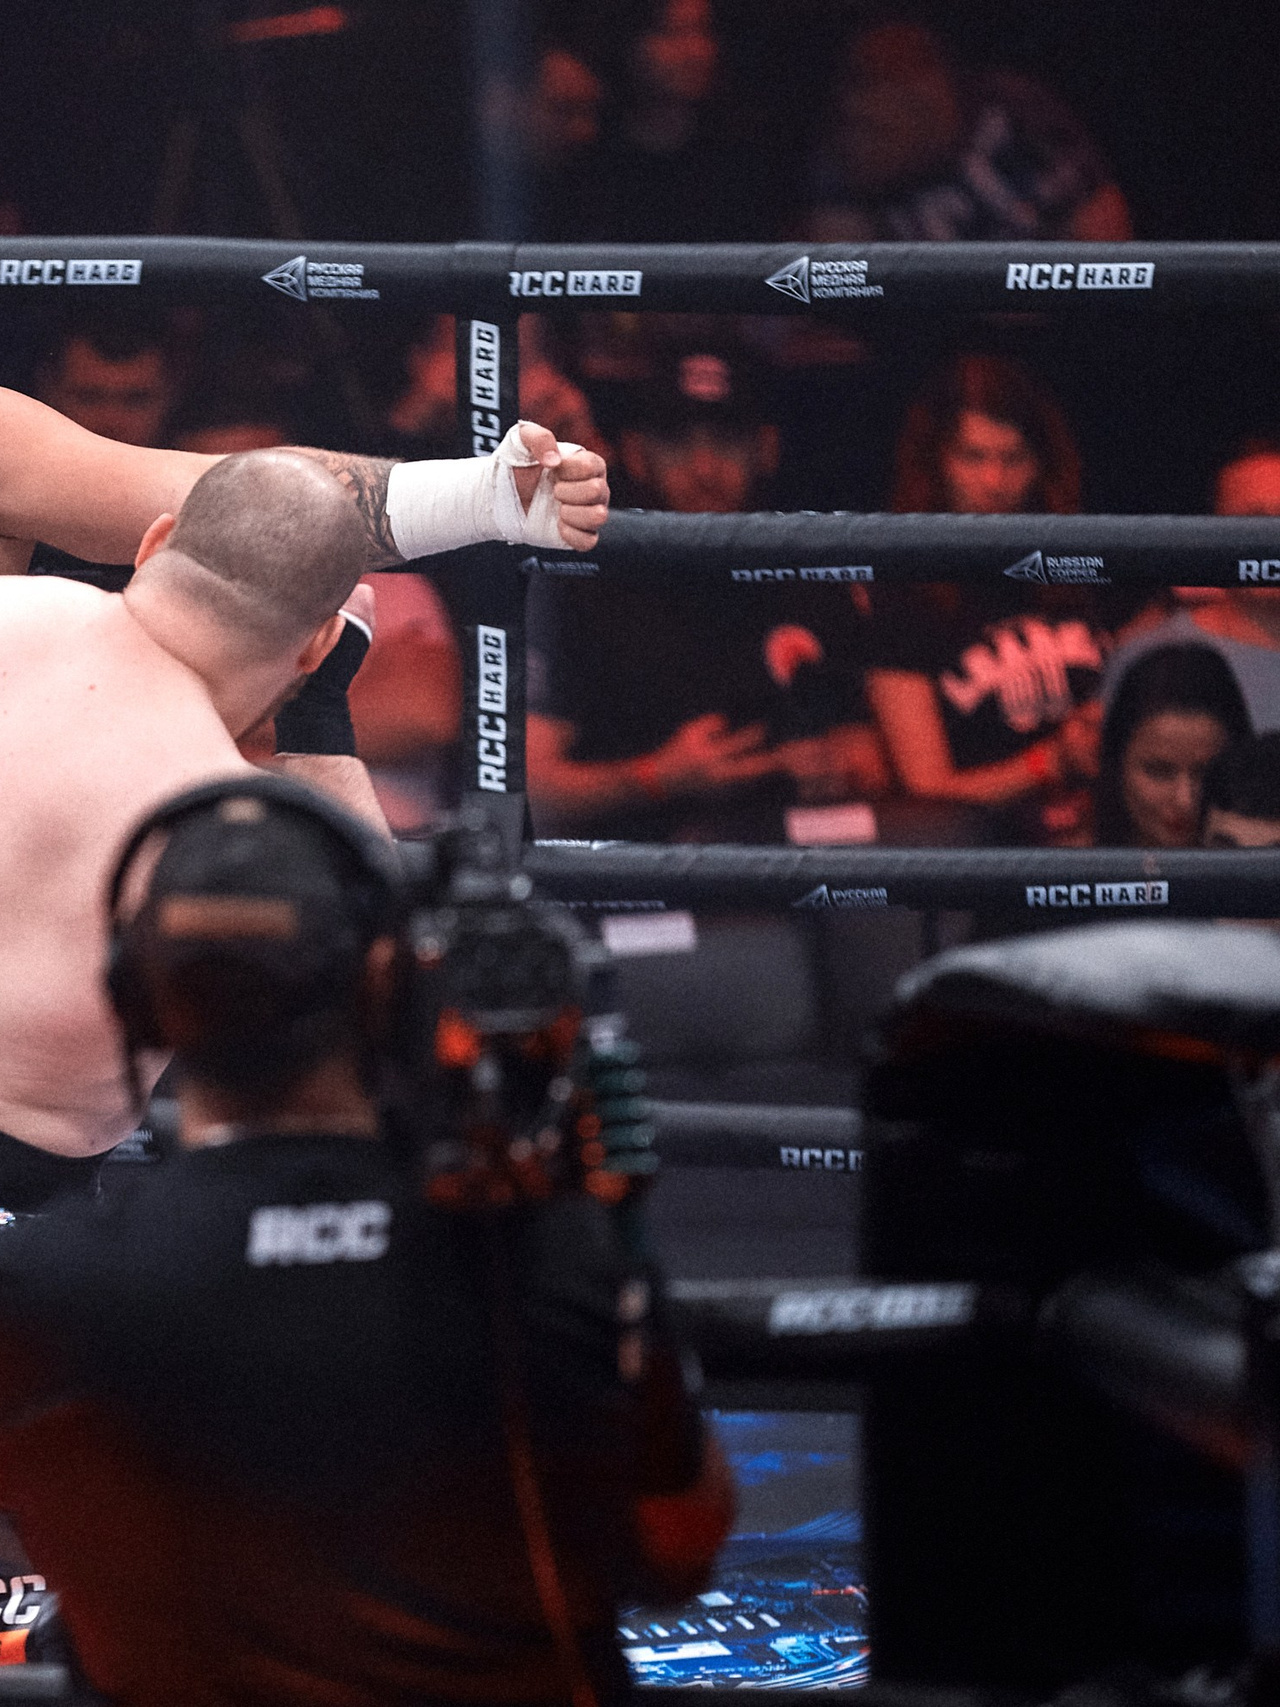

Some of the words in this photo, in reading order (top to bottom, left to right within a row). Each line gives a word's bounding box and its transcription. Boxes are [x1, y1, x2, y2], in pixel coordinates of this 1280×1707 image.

[810, 261, 868, 274] РУССКАЯ
[1006, 264, 1074, 290] RCC
[1046, 556, 1104, 569] RUSSIAN
[478, 715, 507, 793] RCC
[1026, 884, 1091, 908] RCC
